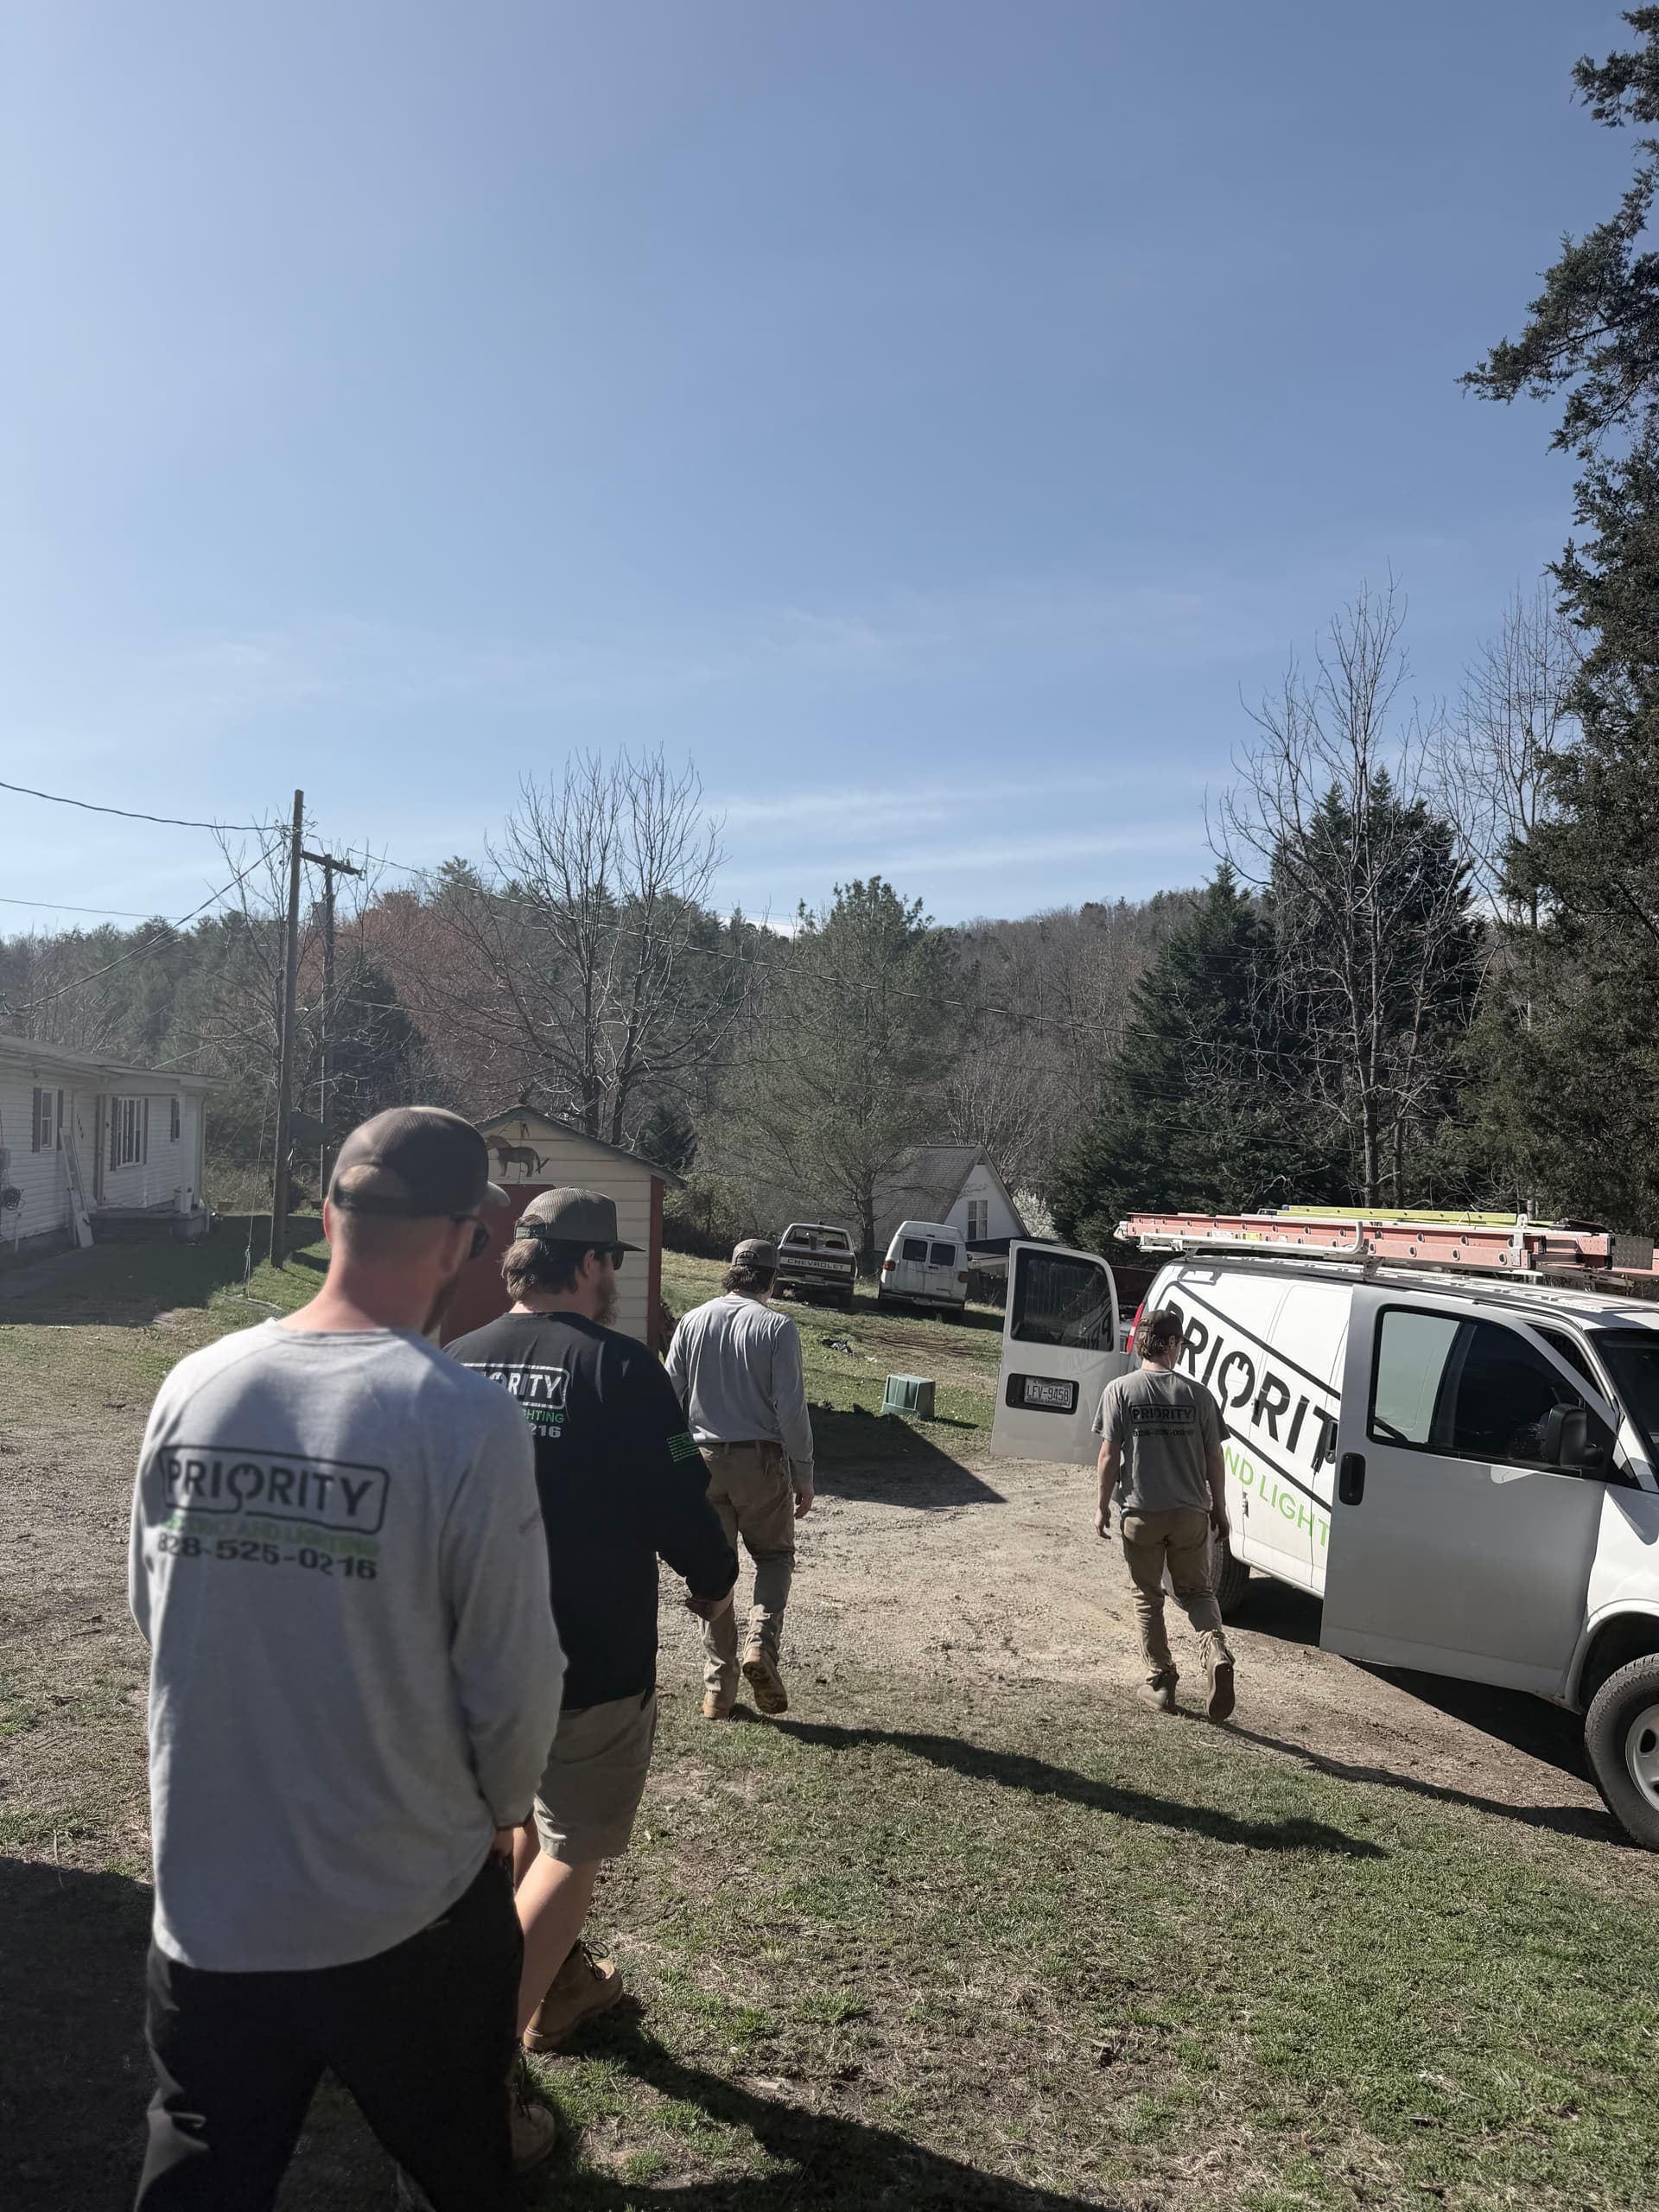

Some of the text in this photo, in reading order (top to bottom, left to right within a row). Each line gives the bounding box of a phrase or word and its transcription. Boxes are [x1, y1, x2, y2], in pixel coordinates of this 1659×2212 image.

[787, 1258, 844, 1270] CHEVROLET
[481, 1370, 562, 1399] ORITY
[1027, 1384, 1069, 1402] LFV-9458
[1165, 1300, 1339, 1472] RIORIT
[521, 1408, 564, 1424] HTING
[1133, 1407, 1192, 1420] PRIORITY
[528, 1422, 562, 1439] 216
[167, 1459, 374, 1516] PRIORITY
[1224, 1445, 1330, 1548] ND LIGHT
[157, 1532, 378, 1580] 828-525-0216
